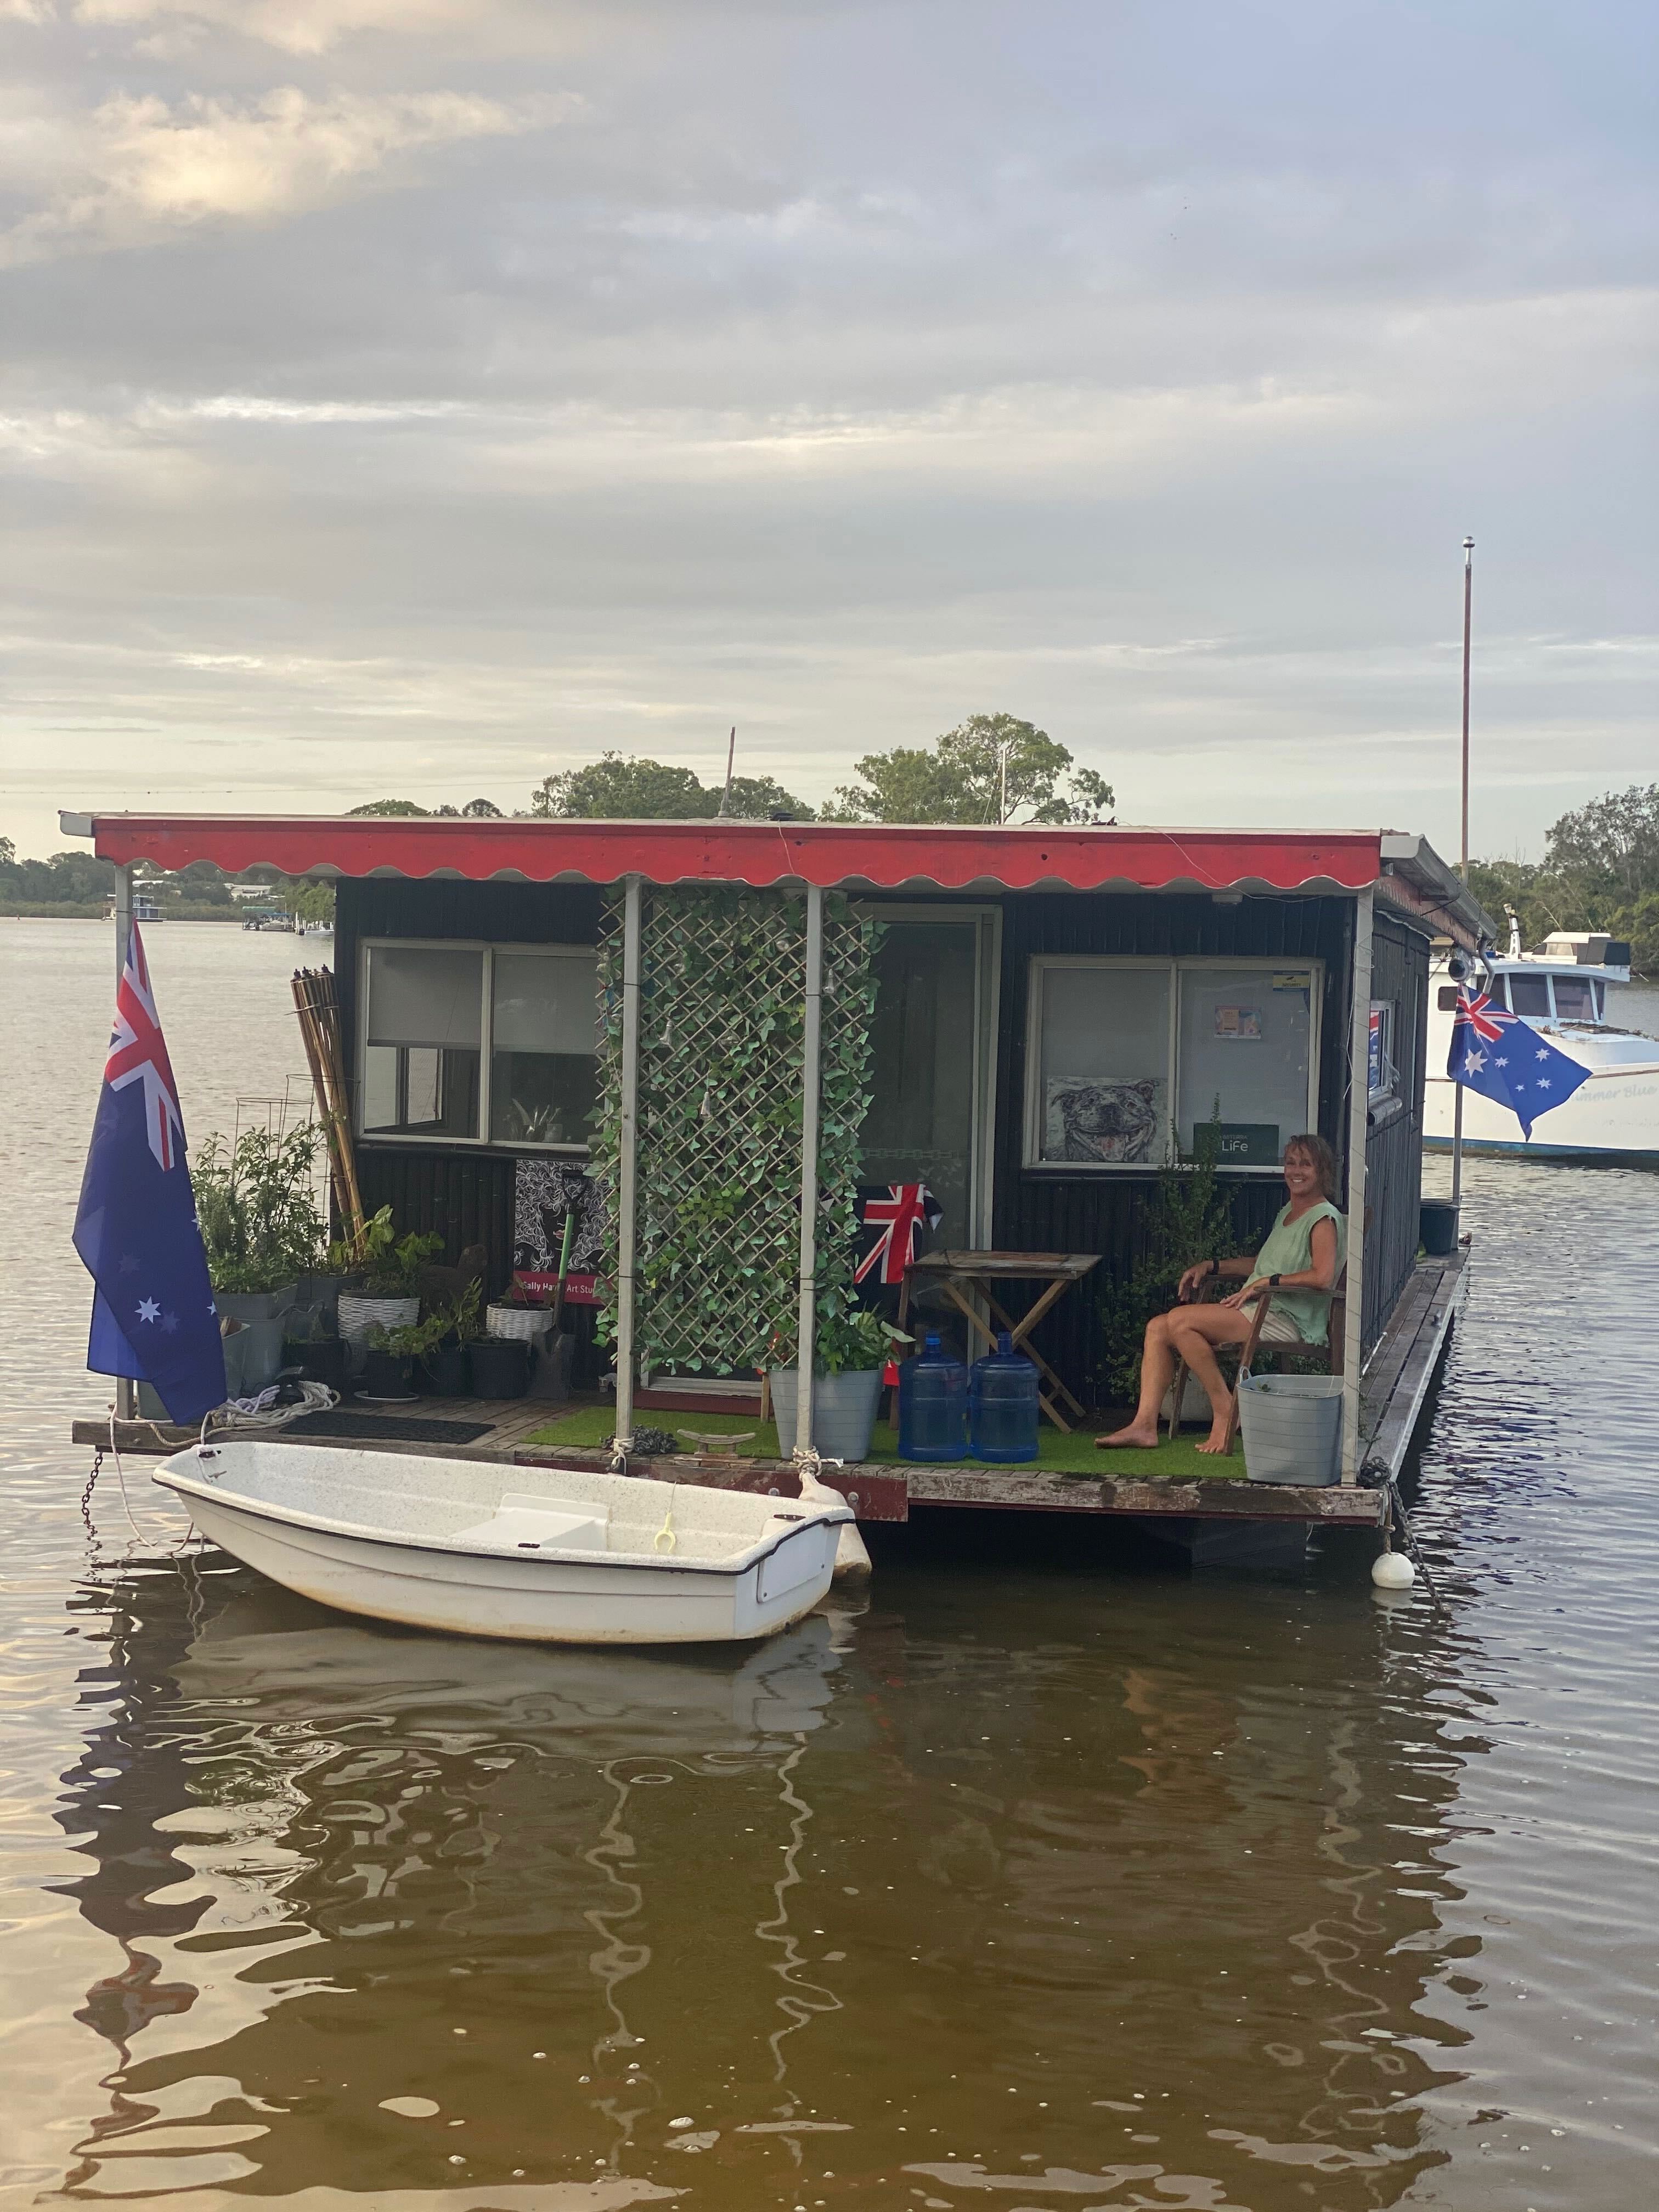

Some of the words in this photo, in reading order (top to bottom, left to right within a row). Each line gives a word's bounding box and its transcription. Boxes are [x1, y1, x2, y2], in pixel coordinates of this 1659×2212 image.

[1572, 1089, 1621, 1102] ummer
[1623, 1084, 1657, 1098] Blue
[523, 1281, 541, 1292] Sally
[566, 1284, 578, 1293] Art
[580, 1285, 593, 1294] Stu
